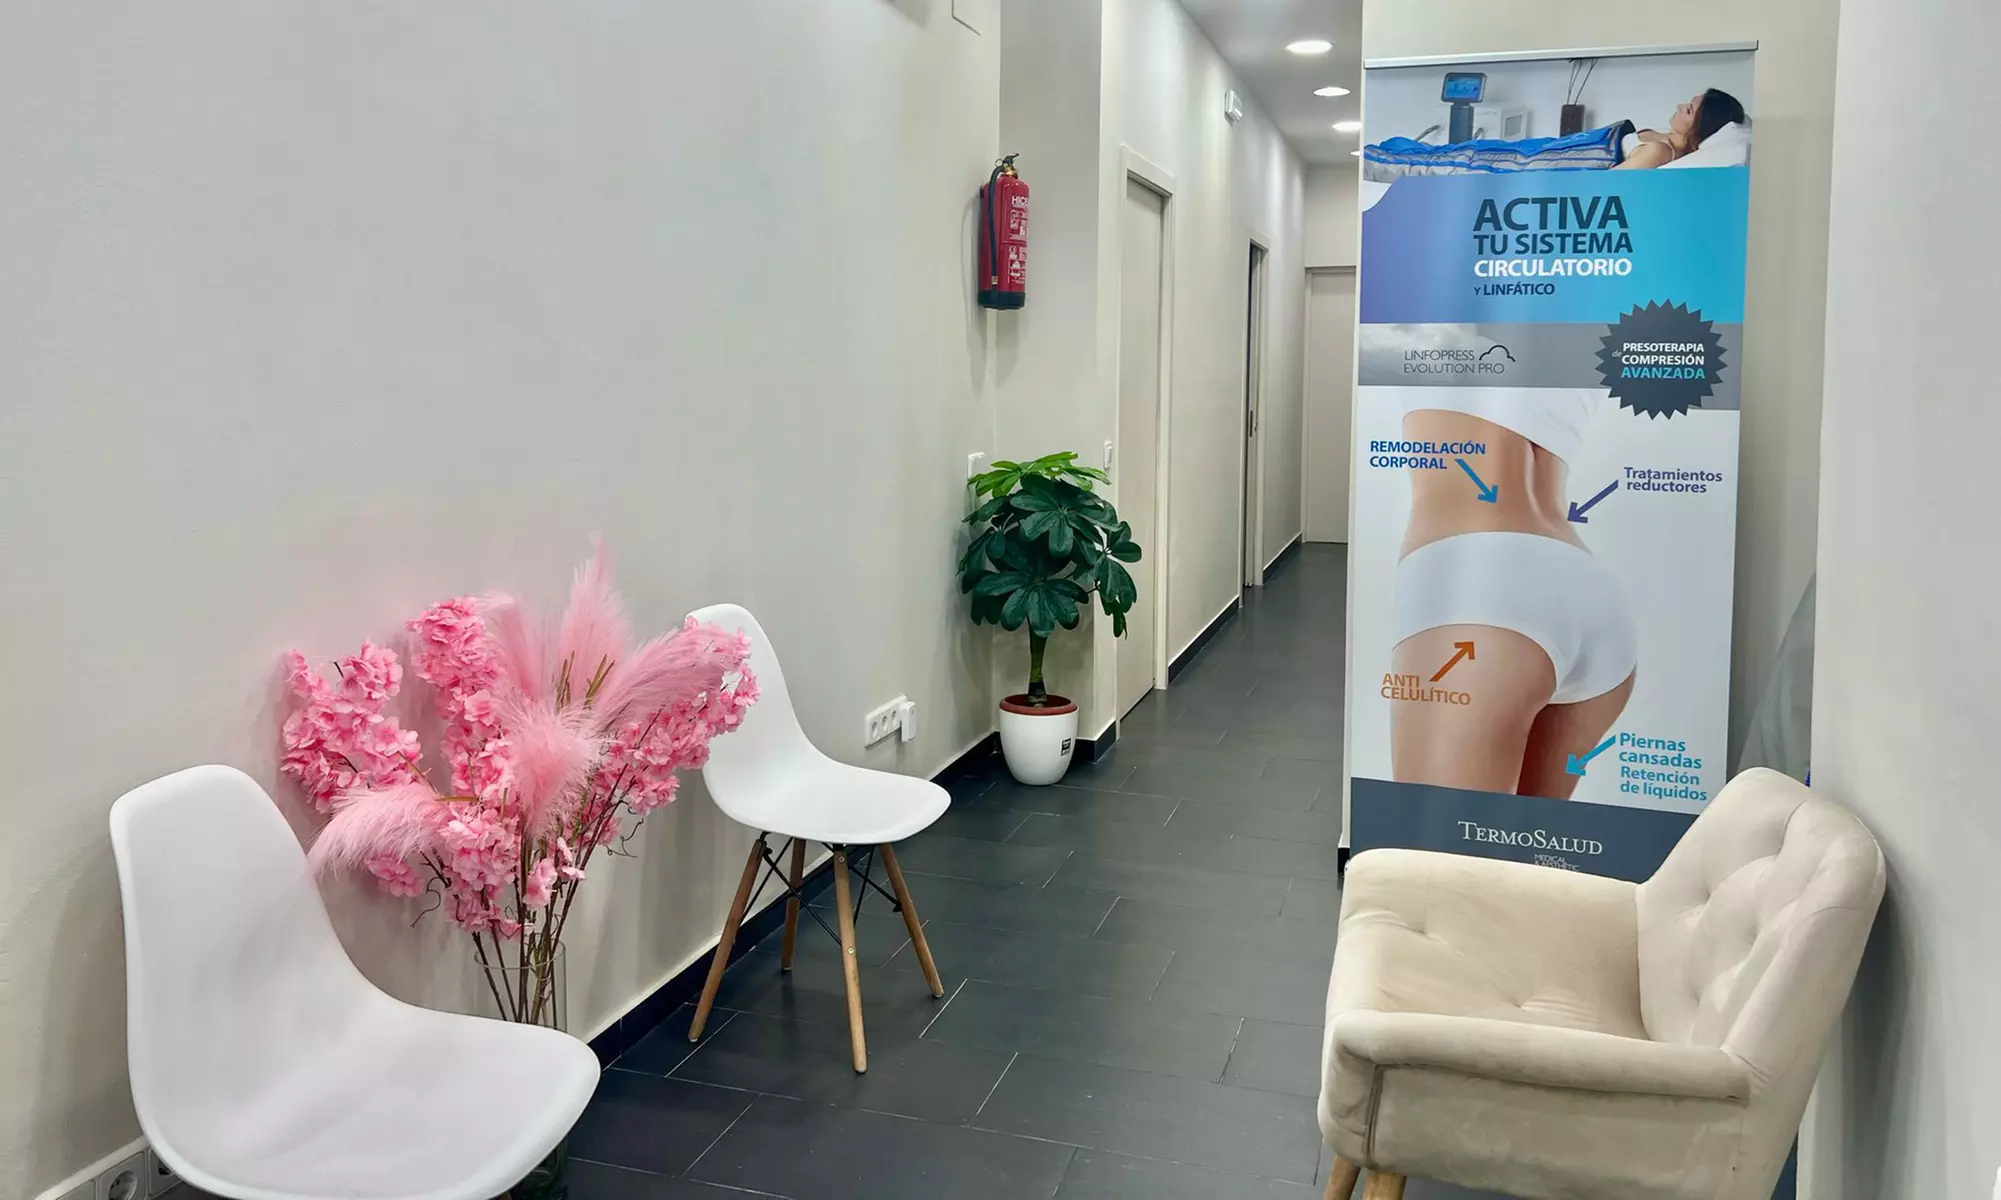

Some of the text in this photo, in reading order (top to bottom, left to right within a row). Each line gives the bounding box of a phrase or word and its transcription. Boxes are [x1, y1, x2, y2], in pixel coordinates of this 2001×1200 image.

[1473, 196, 1629, 232] ACTIVA
[1474, 233, 1633, 255] TU SISTEMA
[1474, 258, 1632, 277] CIRCULATORIO
[1474, 283, 1555, 296] Y LINFÁTICO
[1404, 349, 1475, 361] LINFOPRESS
[1622, 342, 1705, 353] PRESOTERAPIA
[1621, 353, 1705, 366] COMPRESIÓN
[1404, 362, 1505, 375] EVOLUTION PRO
[1620, 366, 1706, 380] AVANZADA
[1369, 440, 1486, 455] REMODELACIÓN
[1369, 456, 1448, 470] CORPORAL
[1623, 466, 1724, 483] Tratamientos
[1626, 480, 1708, 494] reductores
[1382, 672, 1420, 687] ANTI
[1380, 685, 1472, 706] CELULÍTICO
[1618, 732, 1687, 753] Piernas
[1618, 750, 1703, 770] cansadas
[1620, 765, 1701, 786] Retención
[1619, 780, 1708, 802] de líquidos
